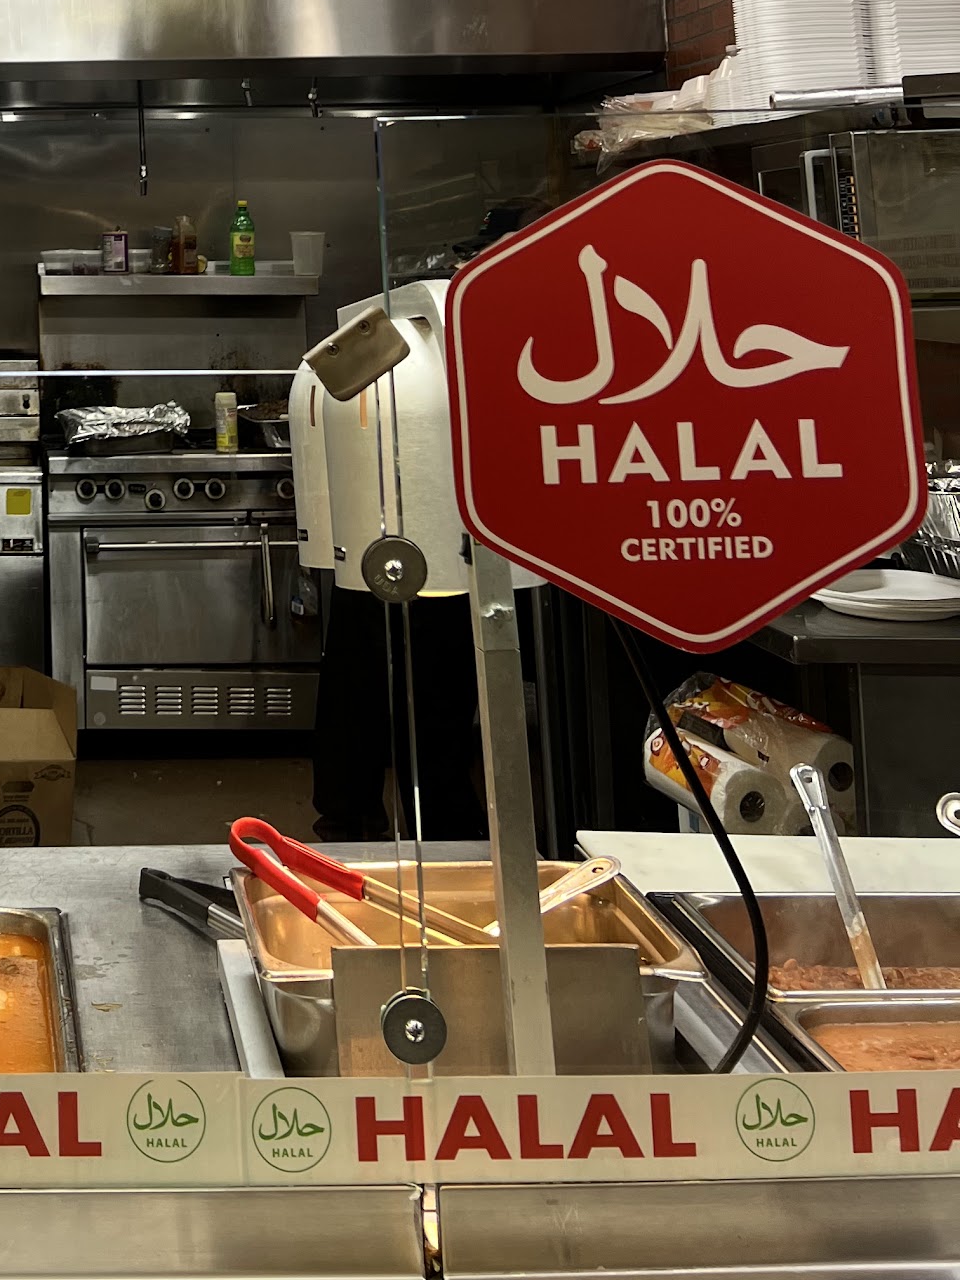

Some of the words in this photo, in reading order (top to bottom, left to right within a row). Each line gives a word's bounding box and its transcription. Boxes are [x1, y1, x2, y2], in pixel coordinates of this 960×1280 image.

[517, 244, 851, 405] حلال
[540, 418, 843, 485] HALAL
[646, 497, 742, 528] 100%
[620, 536, 773, 563] CERTIFIED
[132, 1092, 200, 1131] حلال
[258, 1104, 326, 1142] حلال
[354, 1092, 697, 1163] HALAL
[742, 1094, 809, 1131] حلال
[145, 1136, 189, 1149] HALAL
[271, 1147, 314, 1159] HALAL
[755, 1136, 798, 1148] HALAL
